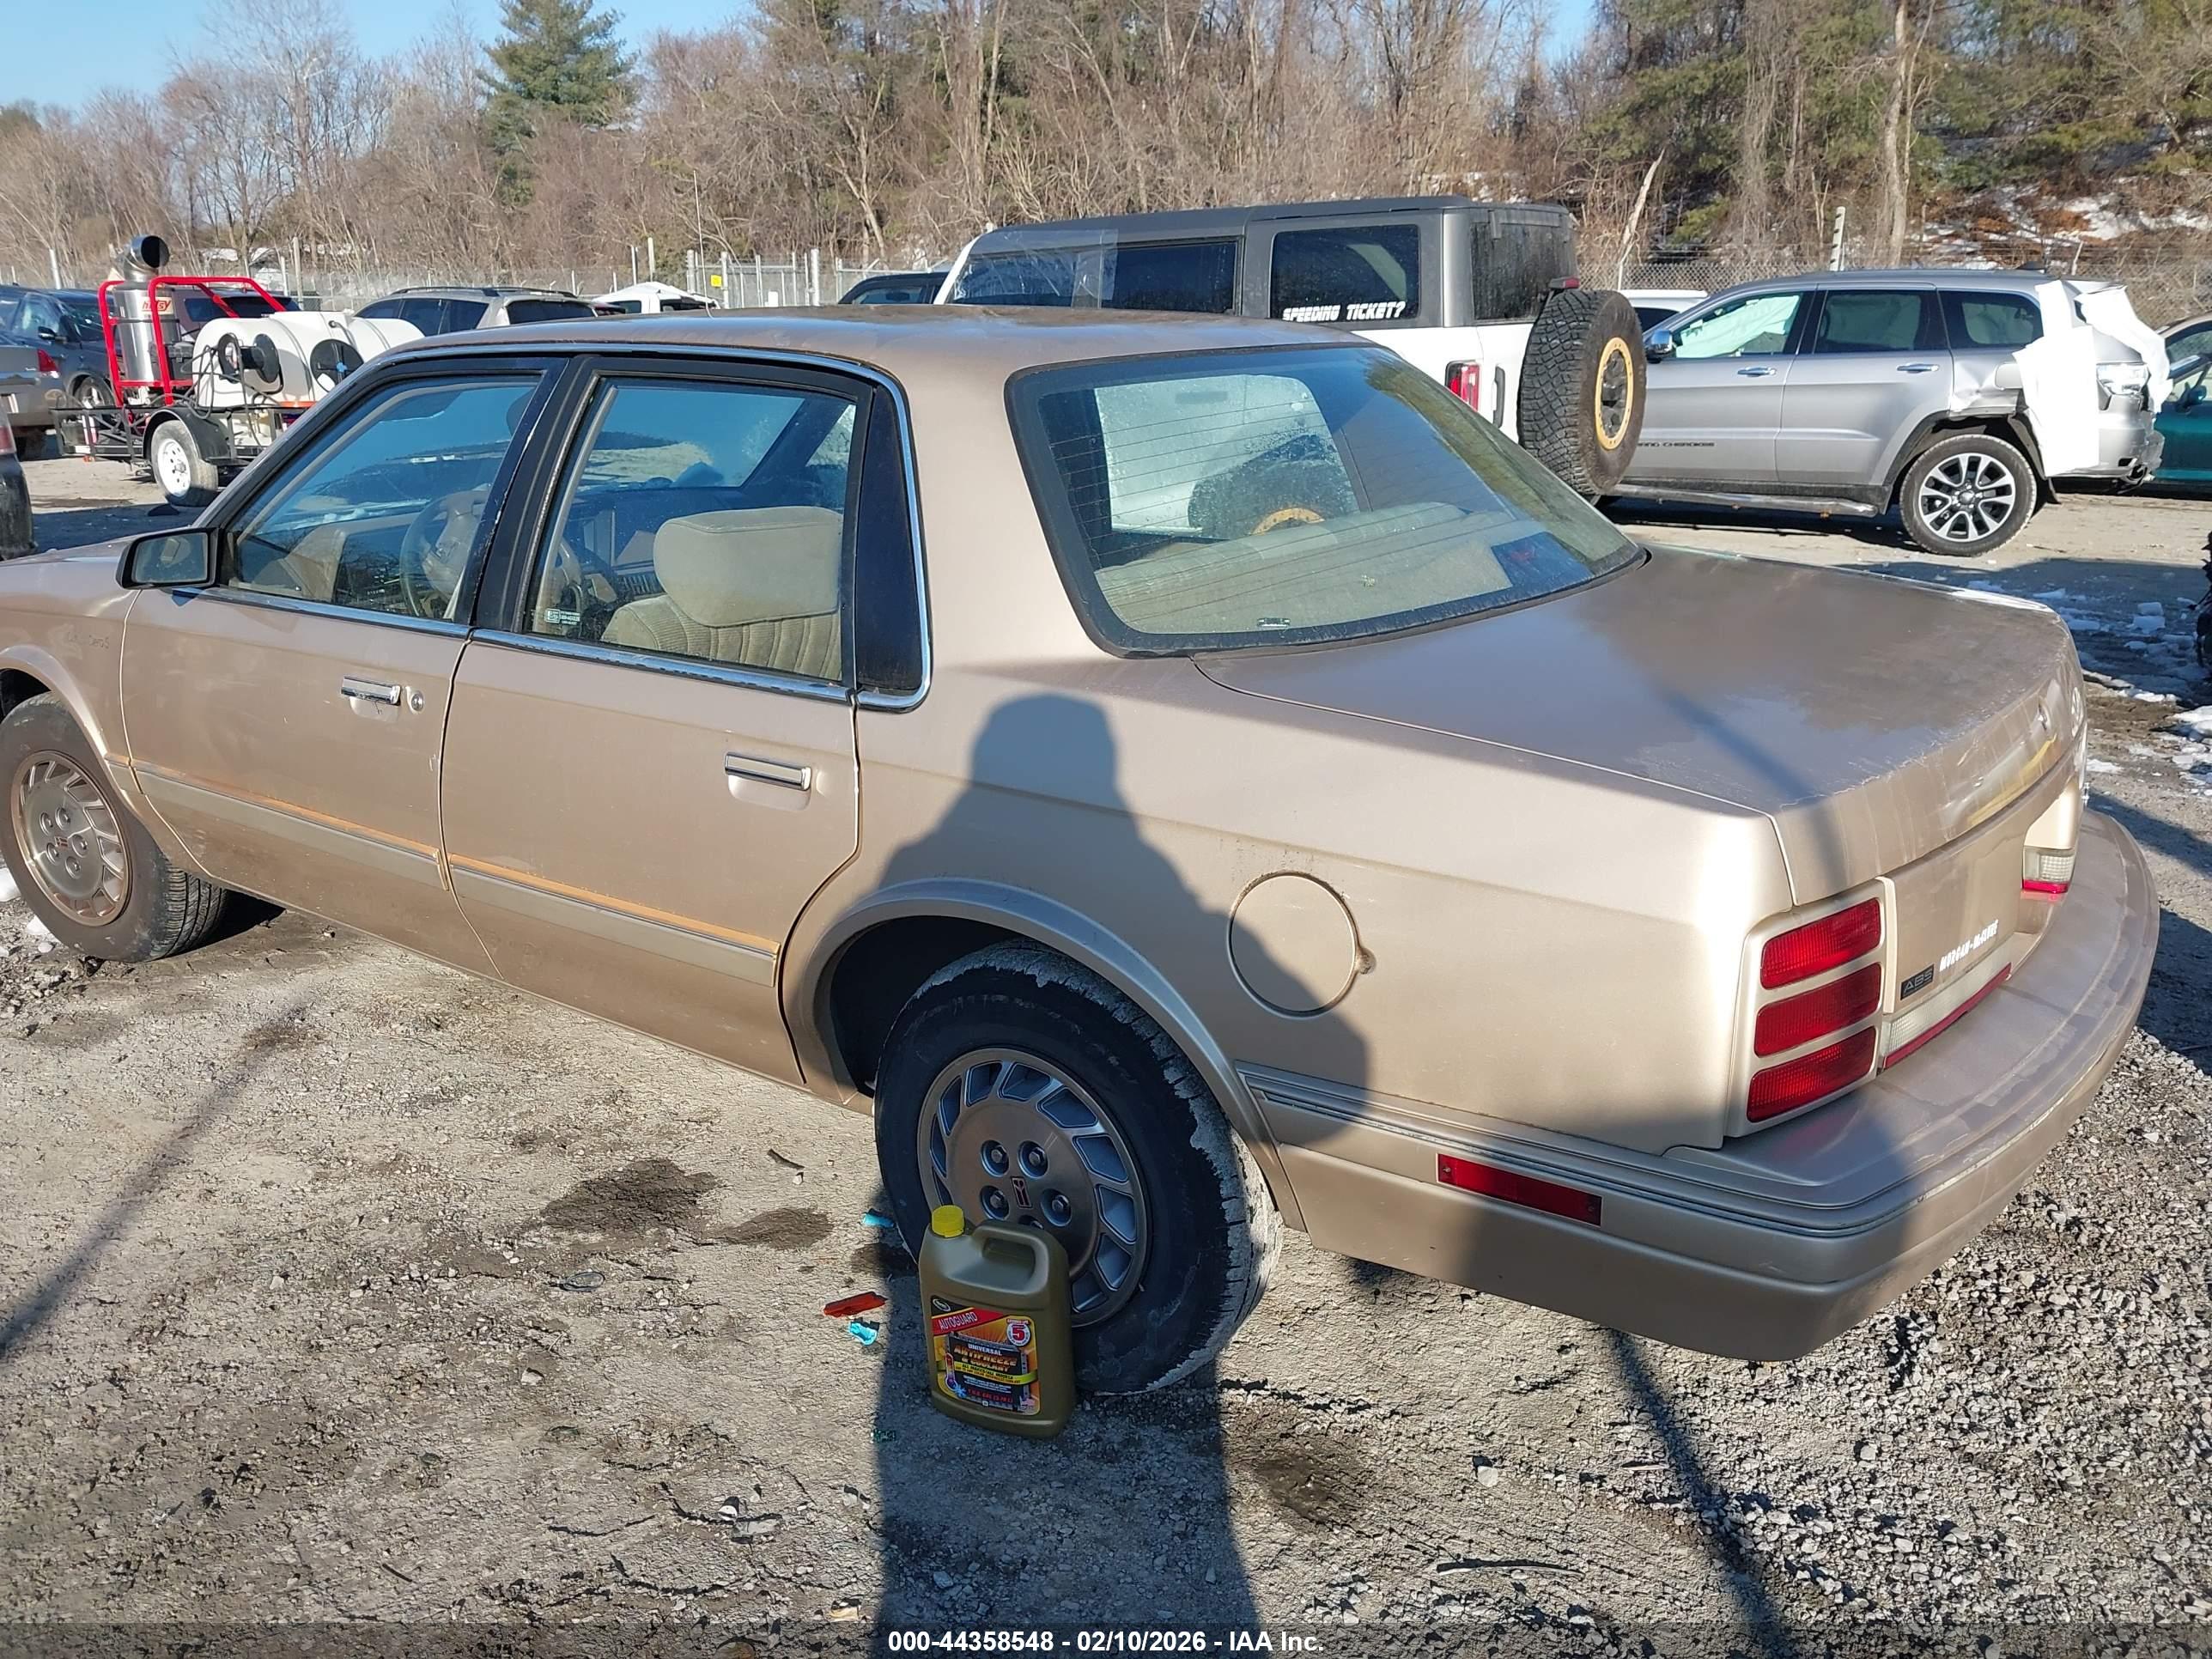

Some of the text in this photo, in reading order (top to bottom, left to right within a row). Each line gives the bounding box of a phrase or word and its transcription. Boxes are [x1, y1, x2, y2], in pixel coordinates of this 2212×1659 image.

[1282, 301, 1407, 322] SPEEDING TICKET?
[1903, 968, 1933, 994] ABS
[938, 1311, 978, 1331] AUTOGUARD
[1012, 1328, 1025, 1341] 5
[953, 1345, 1018, 1367] ANTIFREEZE
[968, 1343, 1003, 1357] UNIVERSAL
[970, 1358, 1011, 1373] COOLANT
